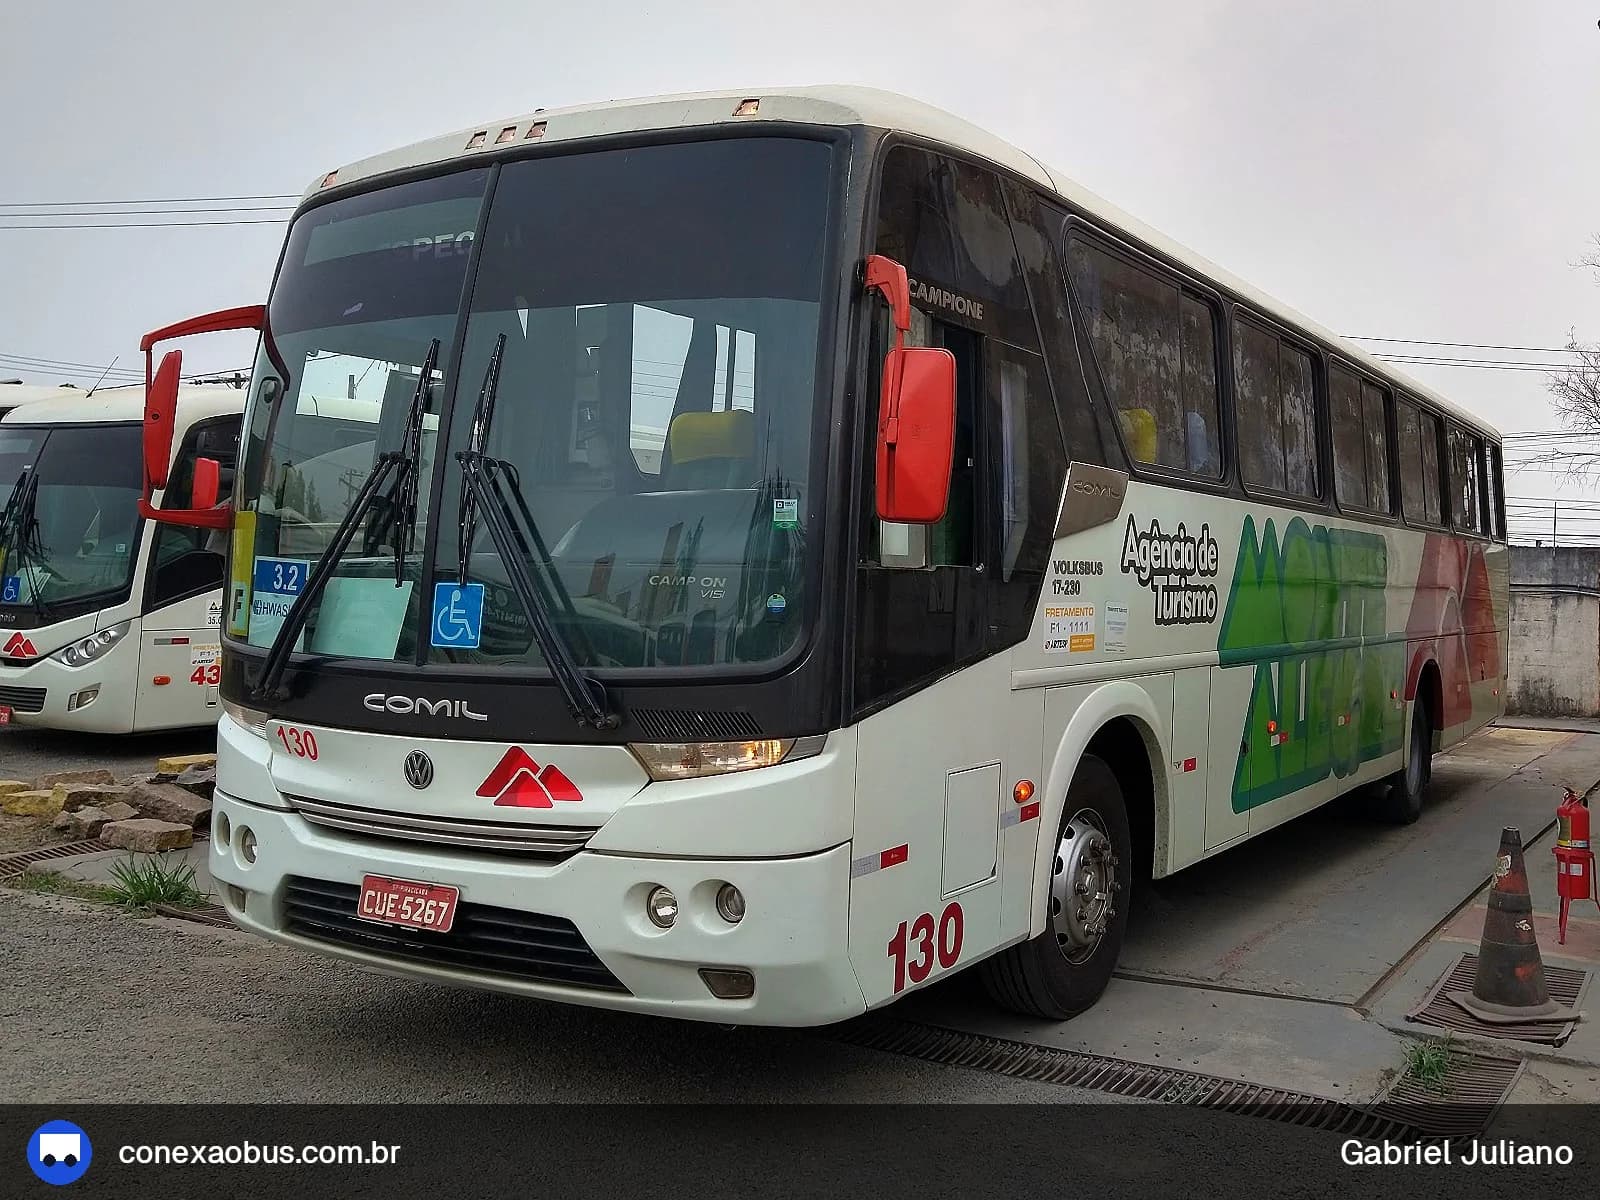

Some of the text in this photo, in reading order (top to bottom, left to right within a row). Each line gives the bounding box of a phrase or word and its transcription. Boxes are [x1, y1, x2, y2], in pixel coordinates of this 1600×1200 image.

[907, 278, 984, 320] CAMPIONE
[1073, 480, 1121, 500] COMIL
[1120, 512, 1218, 587] Agência de
[273, 563, 299, 591] 3.2
[1052, 560, 1104, 576] VOLKSBUS
[1051, 579, 1081, 596] 17-230
[1152, 574, 1218, 626] Turismo
[1045, 606, 1094, 618] FRETAMENTO
[363, 693, 488, 722] COMIL
[276, 725, 319, 761] 130
[363, 890, 450, 926] CUE-5267
[887, 901, 965, 995] 130
